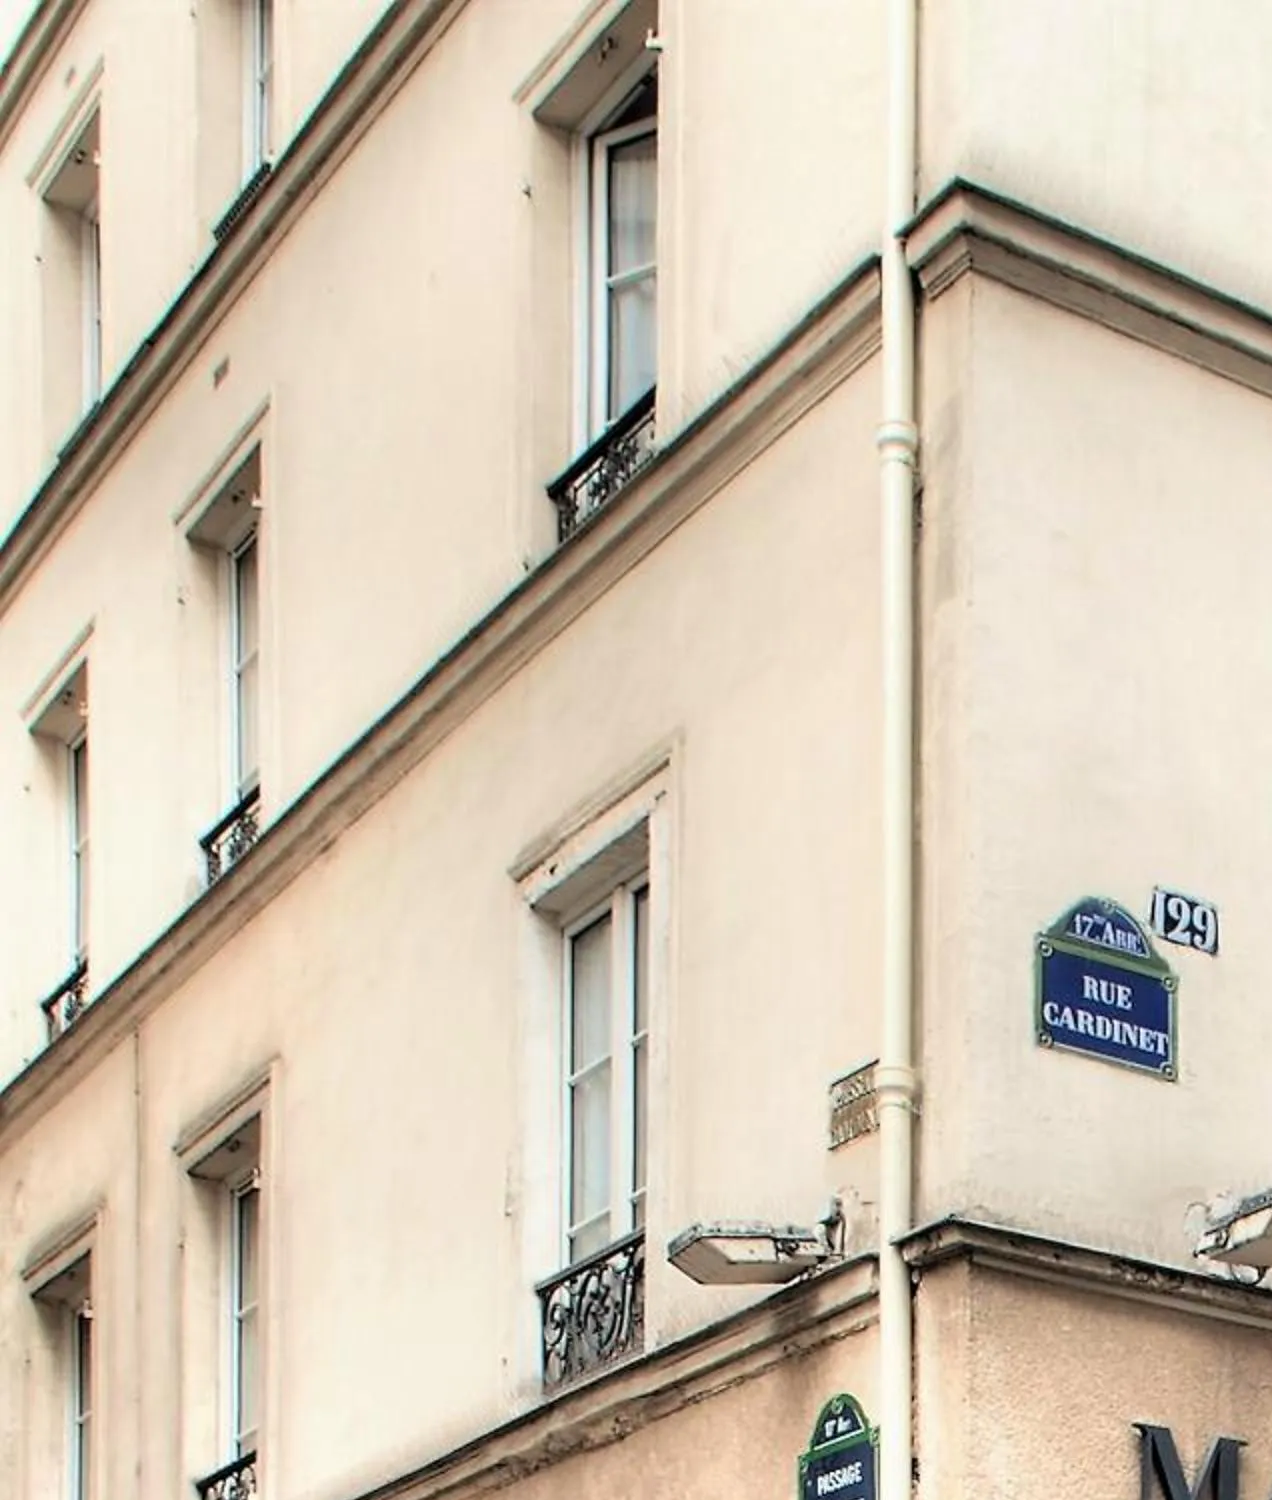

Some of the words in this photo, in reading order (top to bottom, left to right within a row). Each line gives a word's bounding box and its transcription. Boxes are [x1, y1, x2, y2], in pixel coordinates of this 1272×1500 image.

[1152, 891, 1217, 952] 129
[1082, 975, 1133, 1011] RUE
[1043, 1001, 1170, 1056] CARDINET
[817, 1461, 863, 1496] PASSAGE
